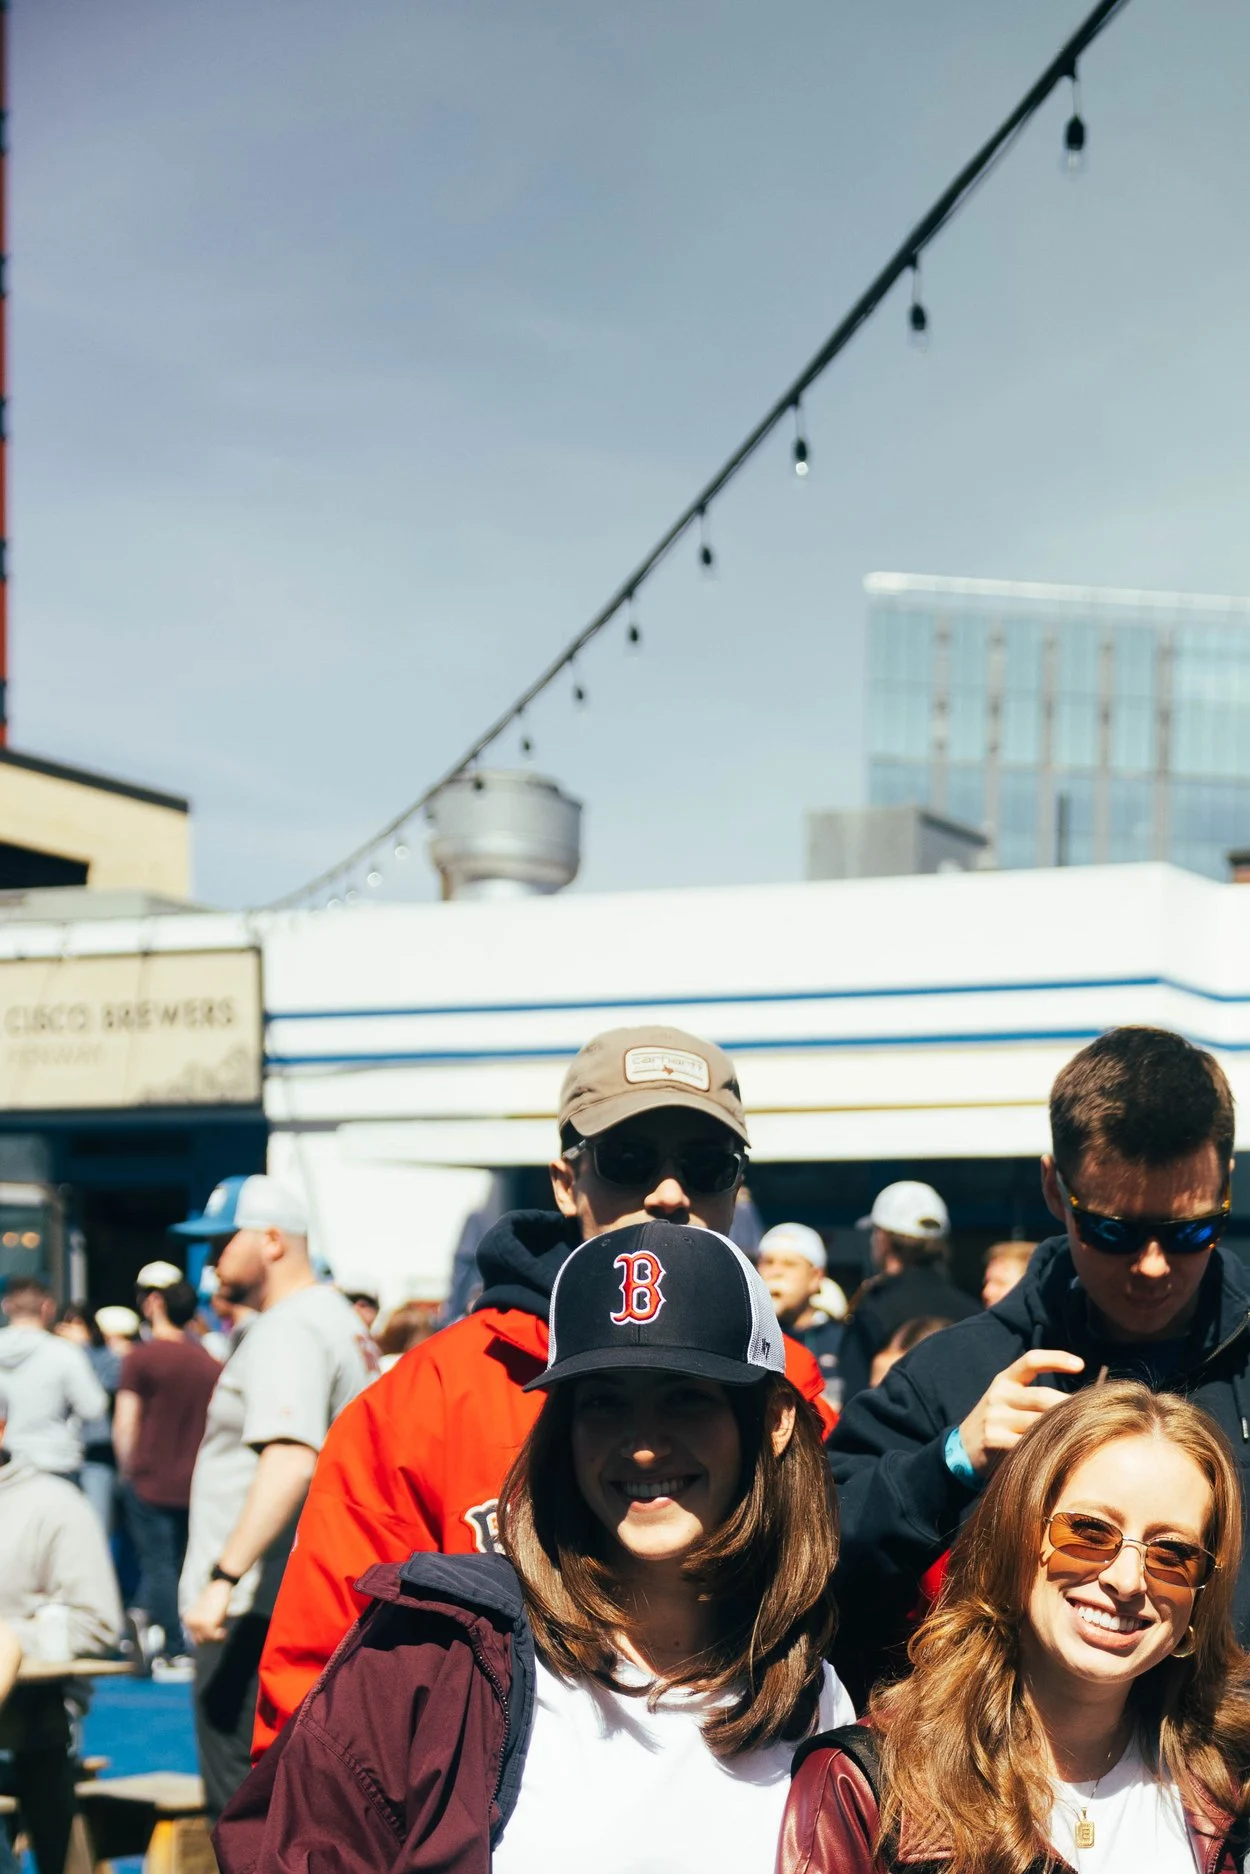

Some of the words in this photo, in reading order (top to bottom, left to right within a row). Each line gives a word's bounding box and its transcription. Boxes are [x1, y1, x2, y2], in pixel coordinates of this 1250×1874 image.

[4, 1002, 92, 1035] CISCO
[101, 996, 237, 1033] BREWERS
[610, 1250, 667, 1325] B
